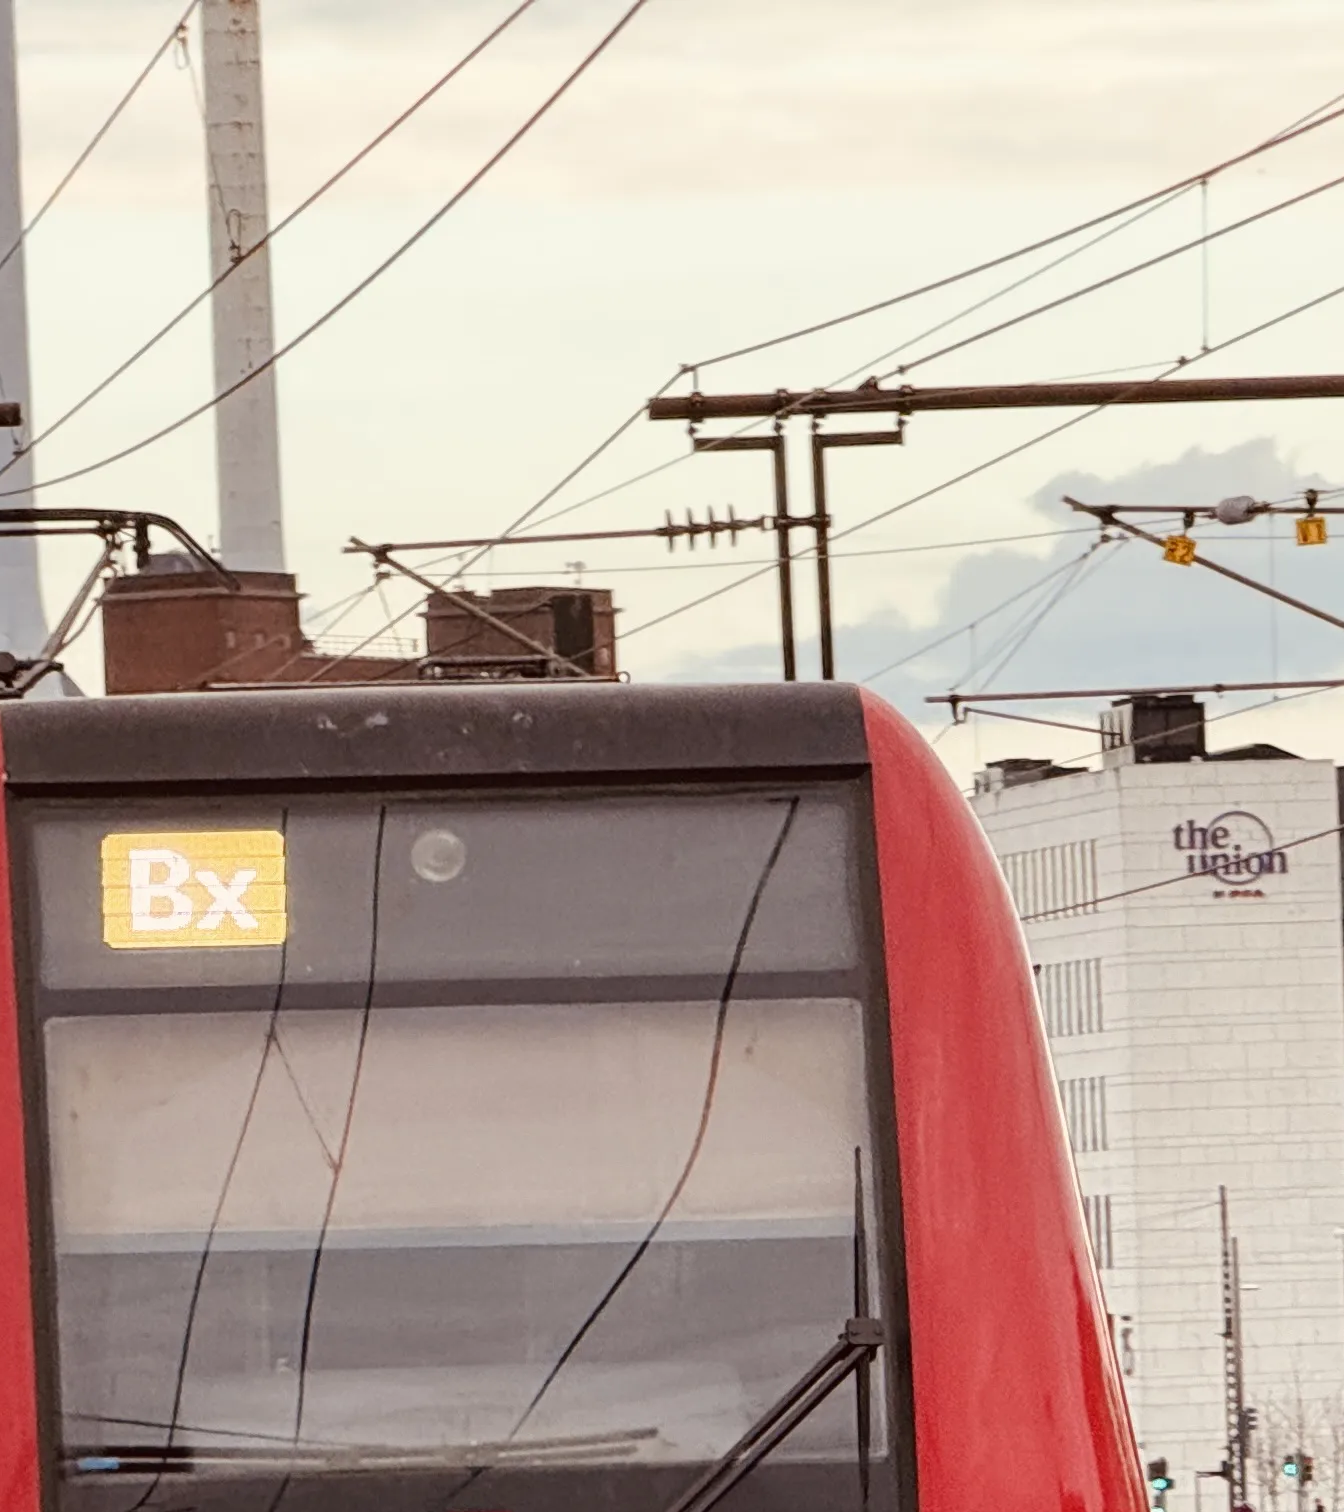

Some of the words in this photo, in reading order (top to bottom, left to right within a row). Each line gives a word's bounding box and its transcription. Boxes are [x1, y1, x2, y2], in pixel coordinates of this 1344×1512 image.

[1173, 819, 1231, 850] the
[1186, 844, 1288, 875] union
[129, 849, 259, 932] Bx
